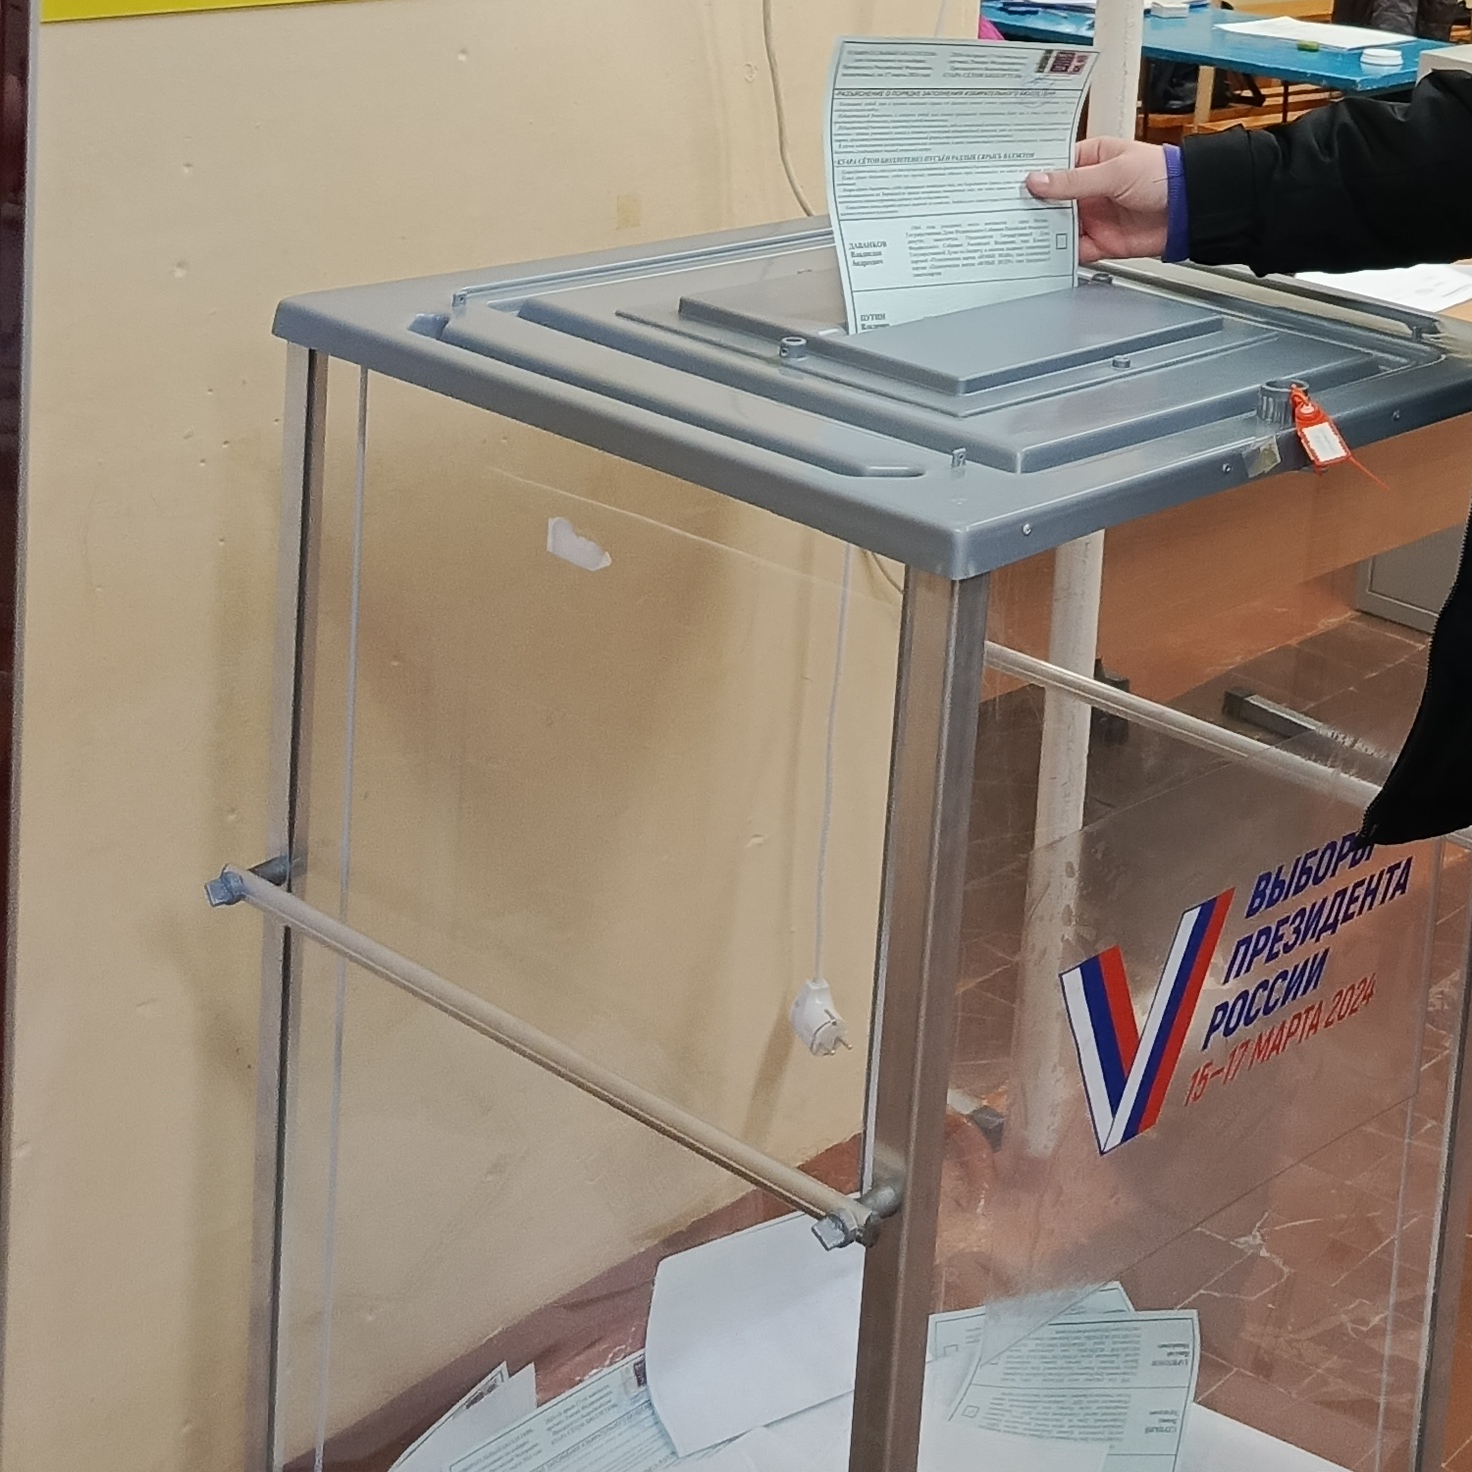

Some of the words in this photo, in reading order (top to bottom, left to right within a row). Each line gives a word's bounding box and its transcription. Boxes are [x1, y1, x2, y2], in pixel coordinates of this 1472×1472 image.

[1222, 856, 1414, 985] ПРЕЗИДЕНТА
[1201, 947, 1328, 1051] РОССИИ
[1248, 1000, 1323, 1071] МАРТА
[1323, 972, 1378, 1028] 2024
